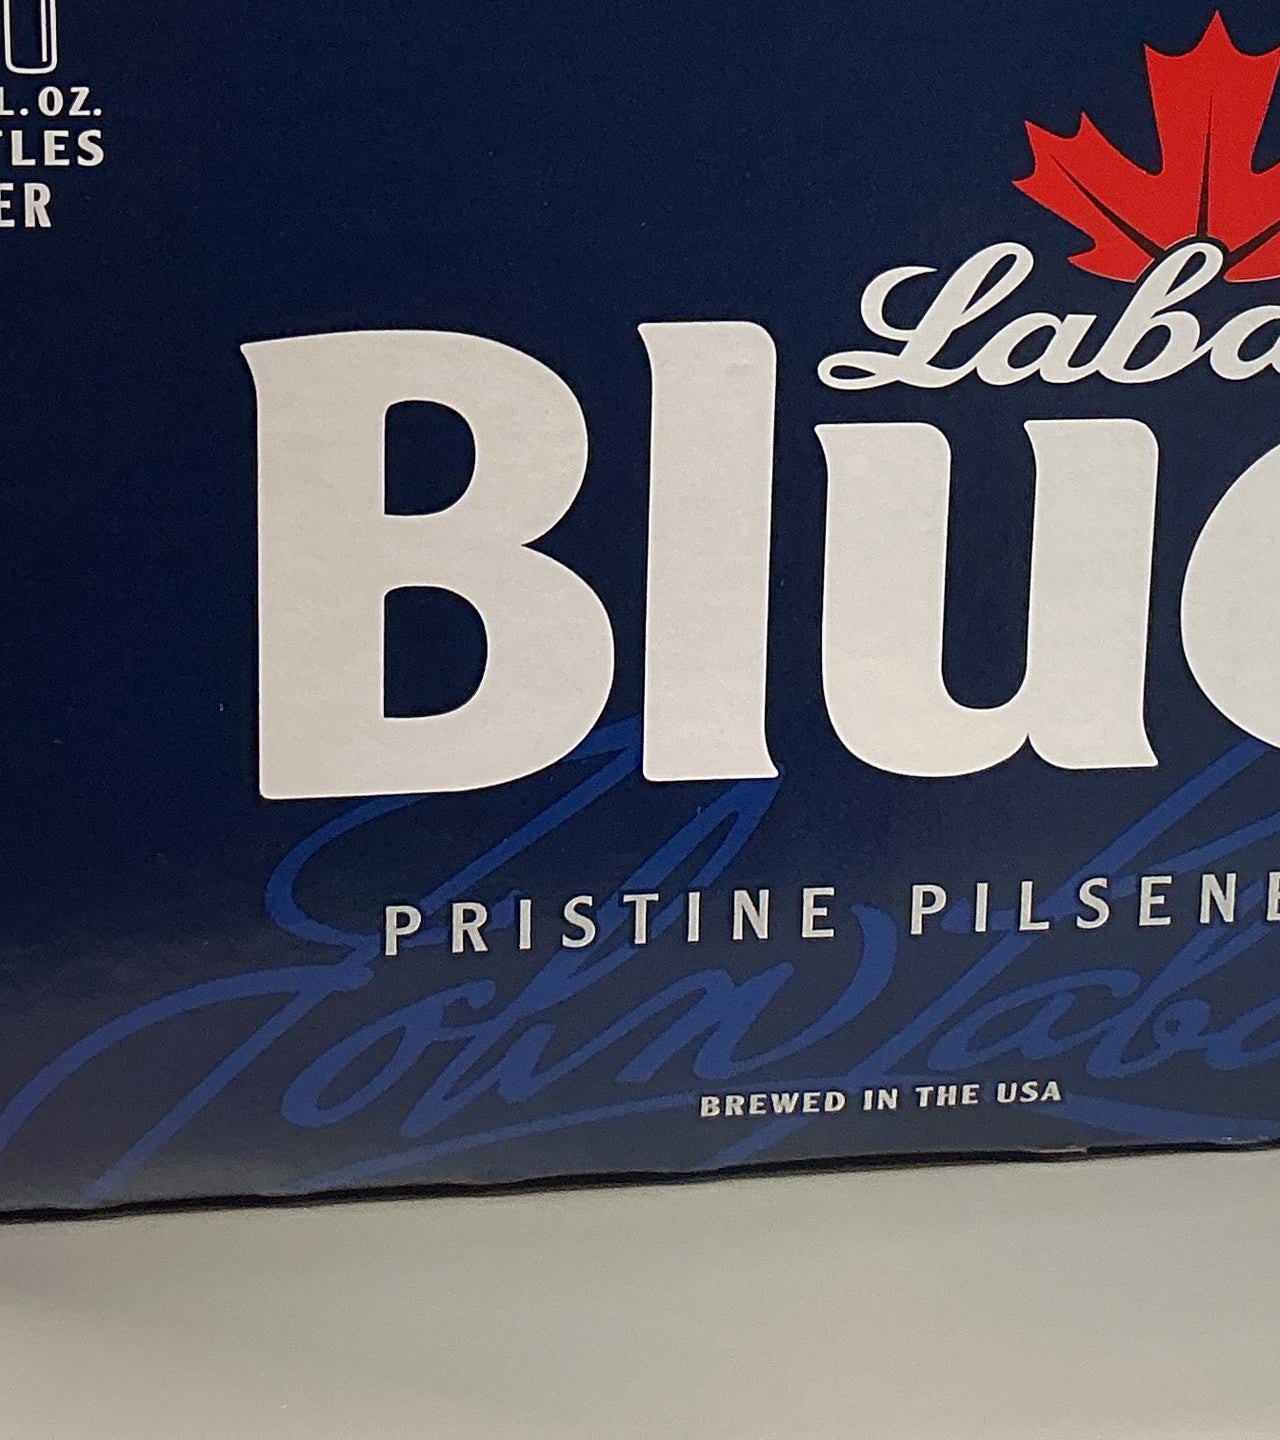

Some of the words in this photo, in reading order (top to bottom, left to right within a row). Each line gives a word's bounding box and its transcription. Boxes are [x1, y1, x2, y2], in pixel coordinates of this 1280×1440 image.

[37, 86, 103, 117] OZ.
[385, 886, 835, 956] PRISTINE
[699, 1090, 847, 1118] BREWED
[862, 1088, 899, 1111] IN
[915, 1083, 981, 1108] THE
[996, 1080, 1063, 1104] USA
